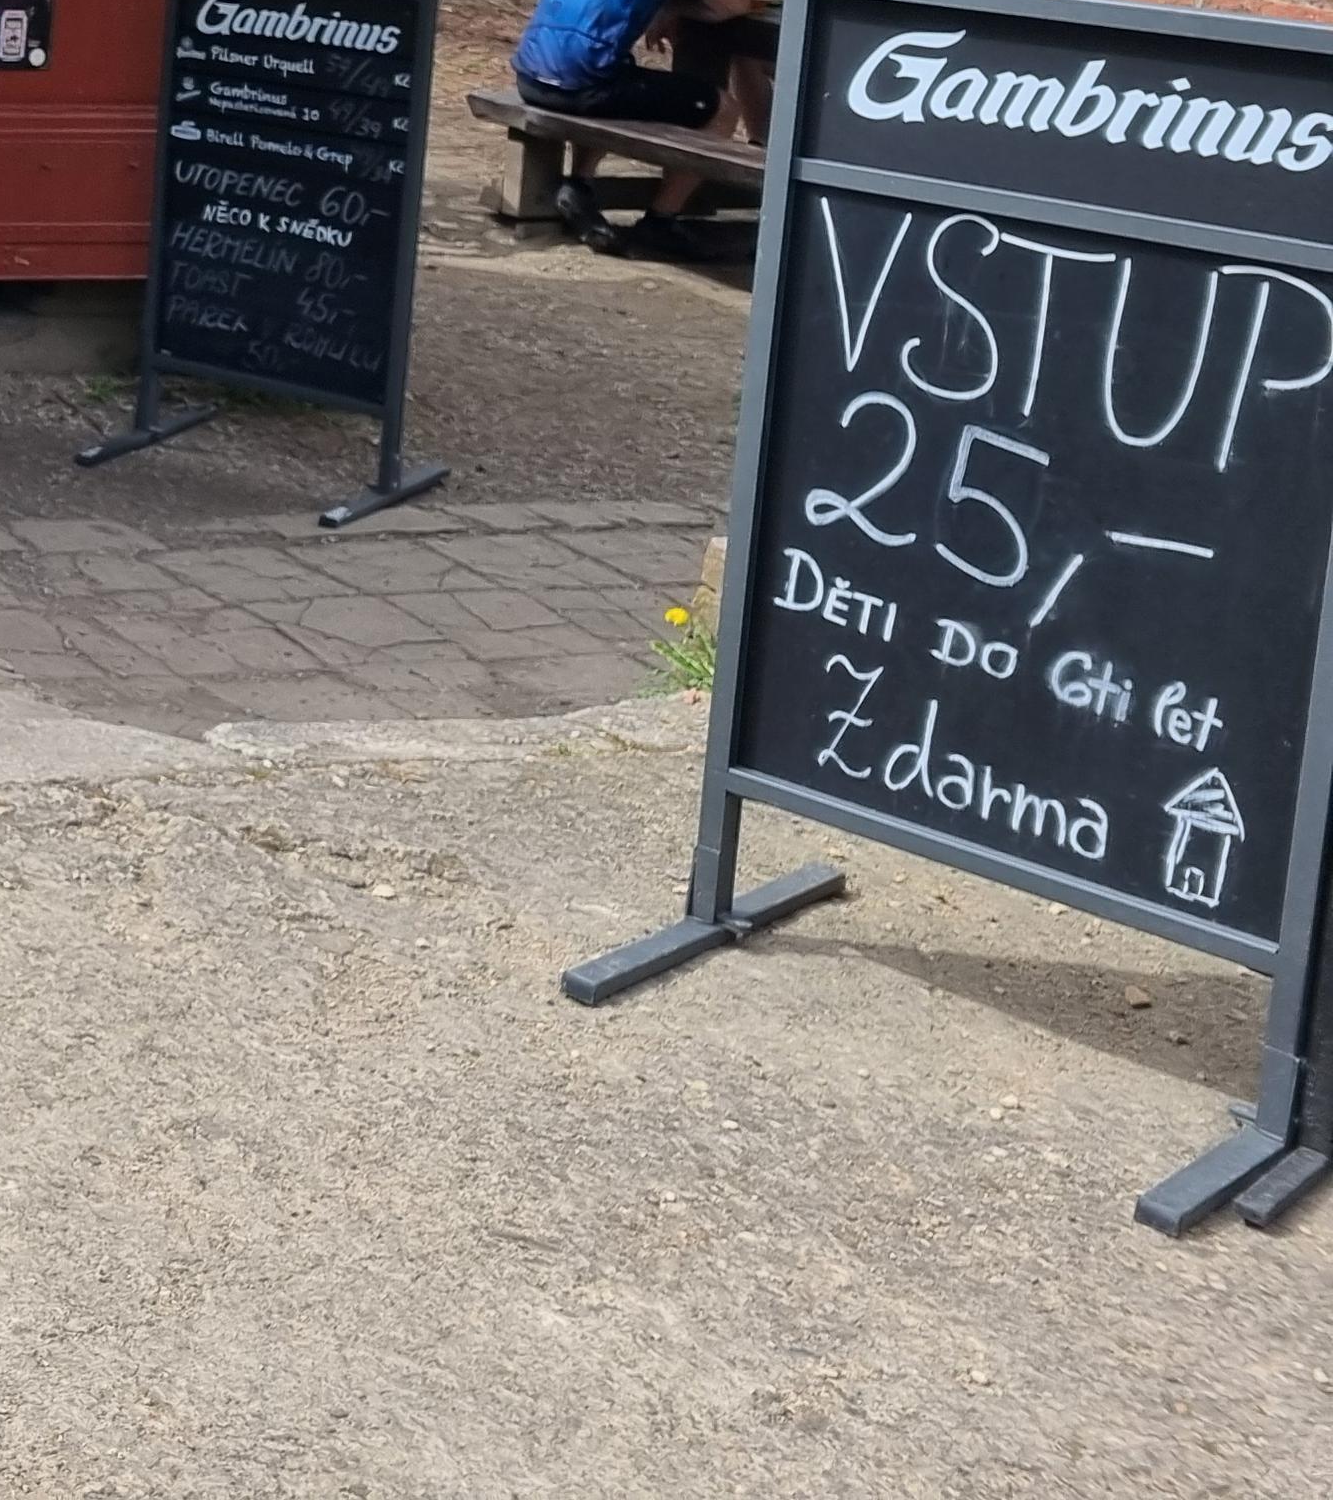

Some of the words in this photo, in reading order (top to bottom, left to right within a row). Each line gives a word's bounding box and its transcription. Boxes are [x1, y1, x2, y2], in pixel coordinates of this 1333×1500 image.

[210, 46, 259, 66] Pilsner
[263, 55, 315, 78] Urquell
[210, 81, 287, 105] Gambrinus
[847, 29, 1333, 172] Gambrinus
[206, 128, 244, 147] Birell
[175, 160, 304, 207] UTOPENEC
[202, 201, 252, 225] NĚCO
[259, 213, 271, 233] K
[276, 217, 352, 247] SNĚDKU
[820, 196, 1333, 473] VSTUP
[773, 548, 897, 642] DĚTI
[929, 618, 1018, 679] DO
[1152, 681, 1223, 751] let
[816, 653, 1109, 860] Zdarma
